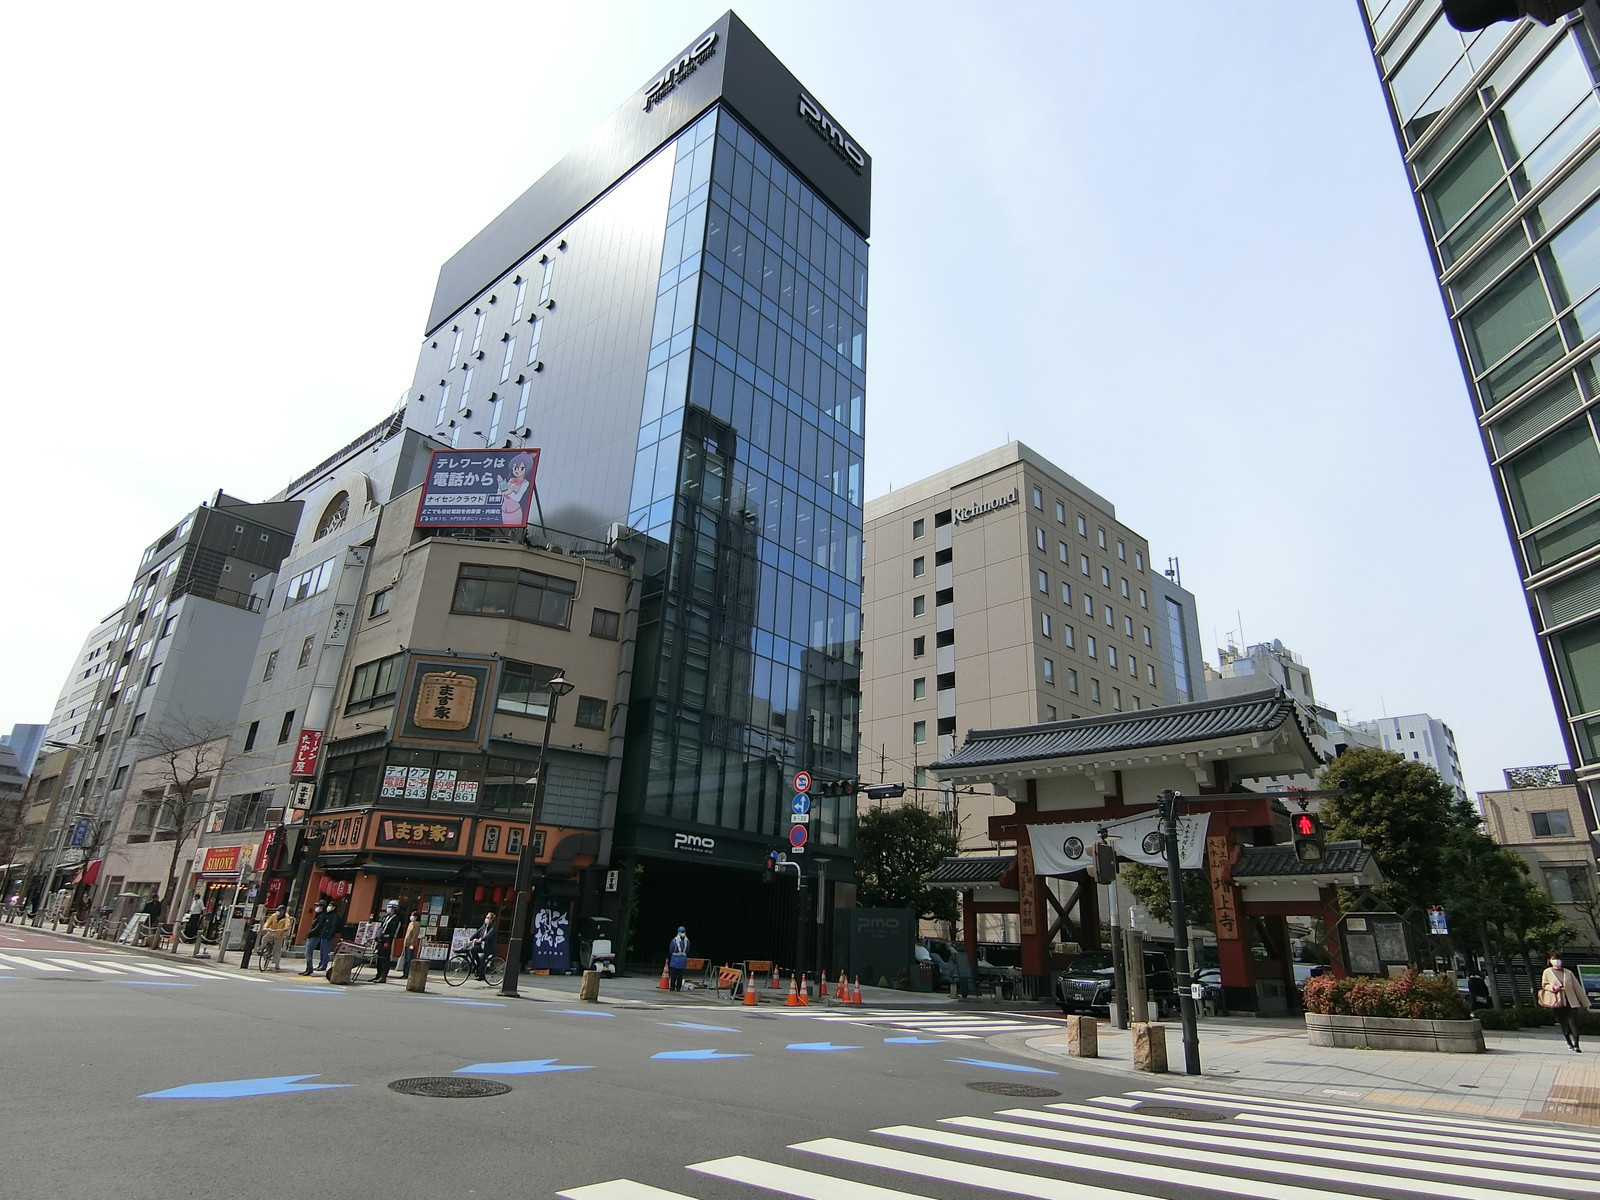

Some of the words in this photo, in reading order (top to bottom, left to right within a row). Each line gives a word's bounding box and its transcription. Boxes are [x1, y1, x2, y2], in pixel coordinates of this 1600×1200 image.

[437, 458, 505, 469] テレワークは
[433, 472, 494, 487] 電話から
[952, 487, 1018, 524] Richmond
[433, 685, 455, 719] ます家
[293, 734, 311, 772] たかし屋
[308, 731, 321, 760] ラーメン
[387, 767, 455, 780] テイクアウト
[384, 776, 478, 792] 電話ご予約受付中
[382, 787, 475, 803] 03-3438-3861
[395, 822, 448, 842] ます家
[1209, 839, 1220, 868] 大本山
[207, 857, 235, 871] SIMONE
[1213, 876, 1235, 932] 増上寺
